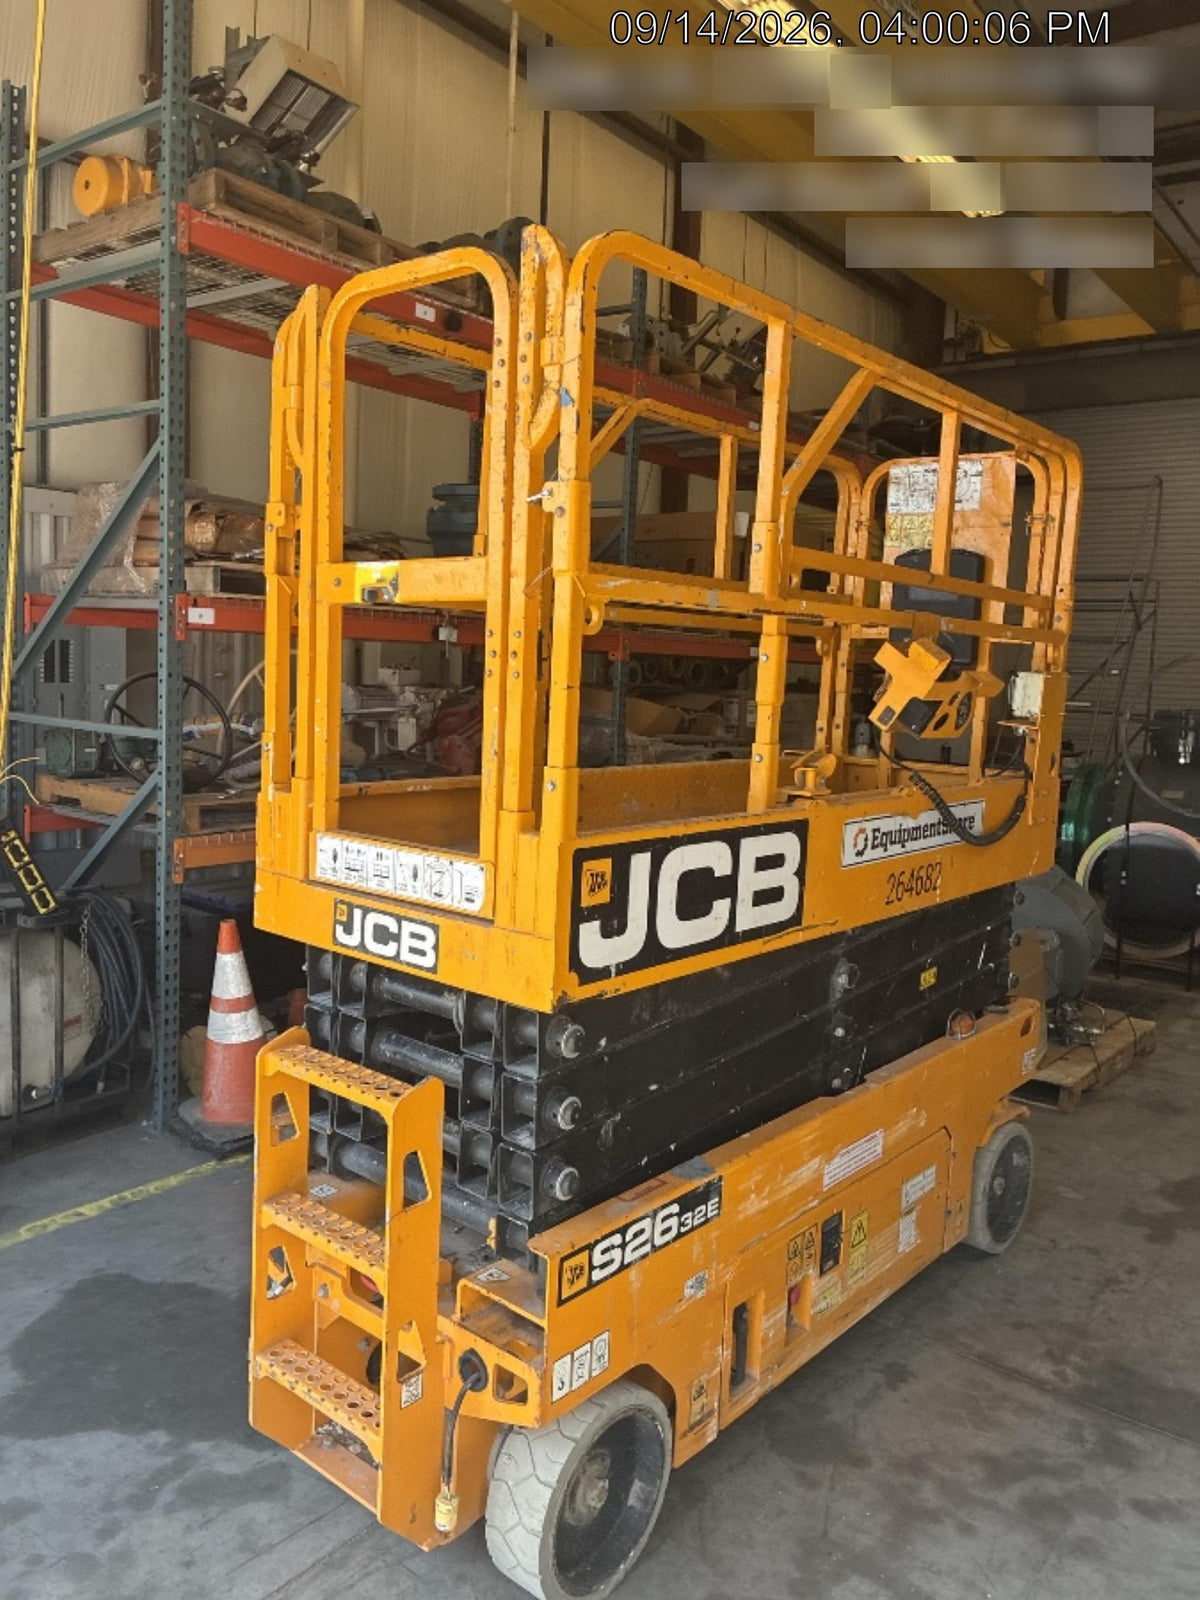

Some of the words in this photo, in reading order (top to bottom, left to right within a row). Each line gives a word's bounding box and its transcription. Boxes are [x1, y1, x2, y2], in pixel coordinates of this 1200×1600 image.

[871, 815, 975, 852] EquipmentSare
[579, 831, 801, 968] JCB
[885, 861, 942, 905] 264682
[335, 907, 436, 968] JCB
